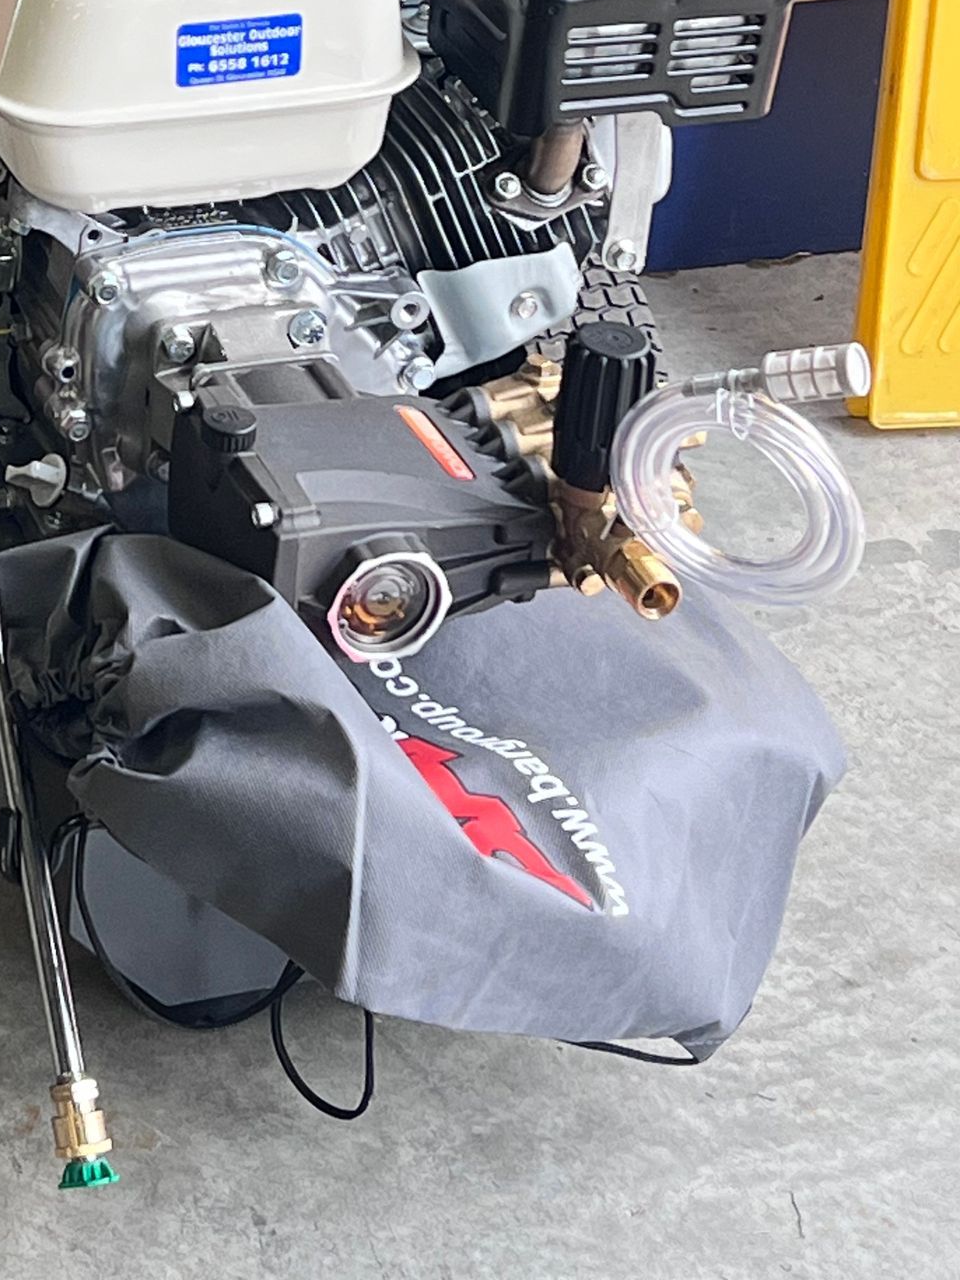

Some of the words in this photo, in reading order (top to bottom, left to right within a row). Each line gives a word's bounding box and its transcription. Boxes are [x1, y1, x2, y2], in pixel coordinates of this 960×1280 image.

[178, 32, 246, 48] Gloucester
[248, 25, 301, 41] Outdoor
[209, 41, 269, 57] Solutions
[208, 57, 248, 73] 6558
[251, 53, 290, 68] 1612
